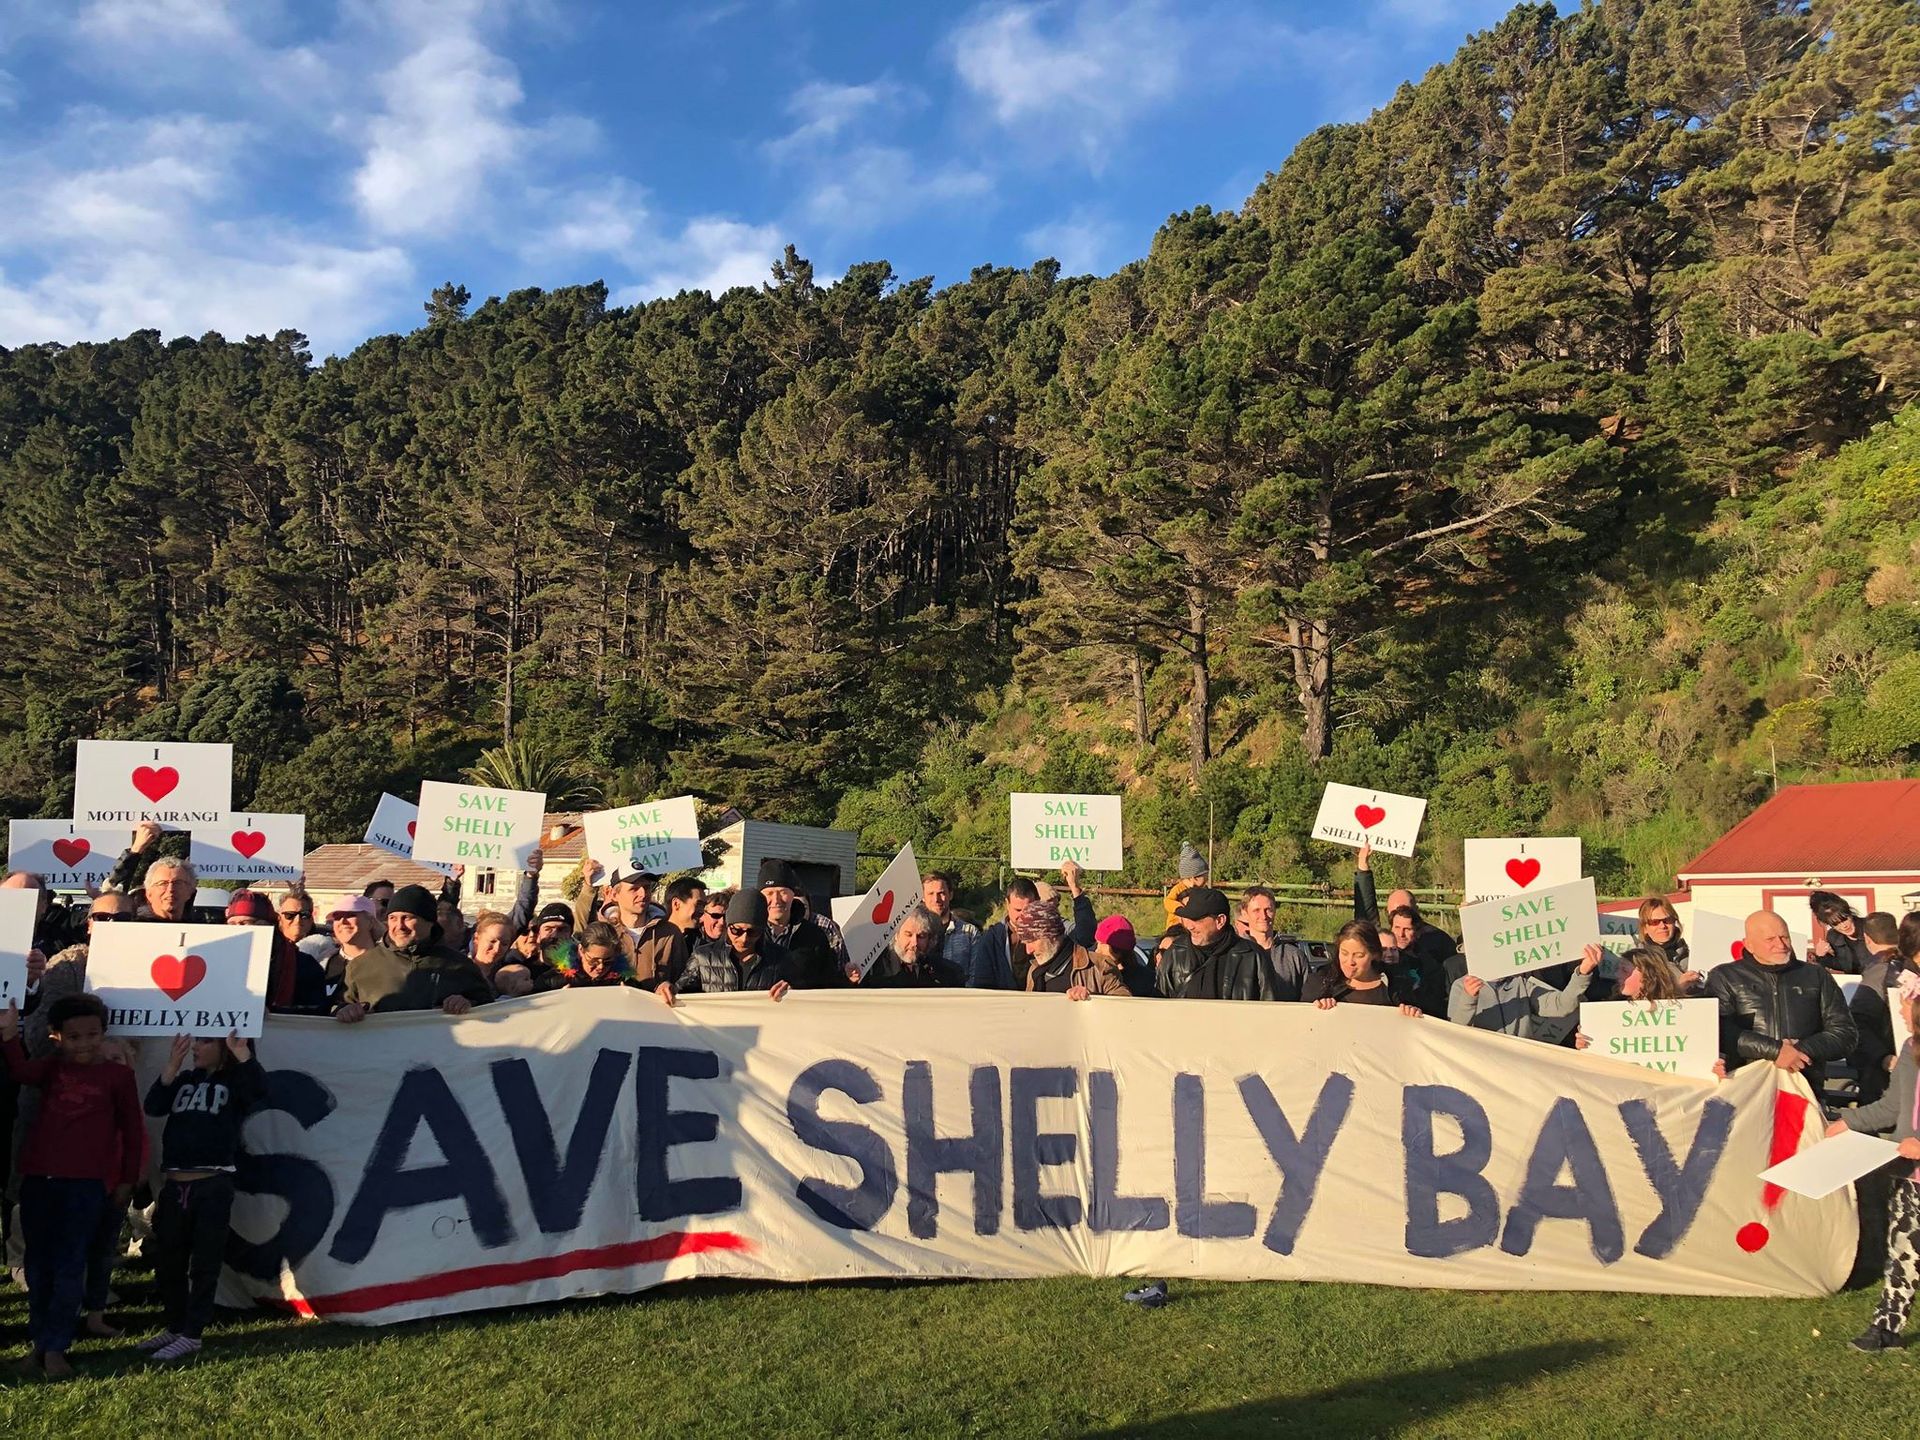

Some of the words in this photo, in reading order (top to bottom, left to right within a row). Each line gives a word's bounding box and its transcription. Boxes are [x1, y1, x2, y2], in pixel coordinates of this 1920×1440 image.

[153, 748, 160, 760] I
[458, 792, 509, 813] SAVE
[1372, 794, 1377, 803] I
[87, 810, 136, 821] MOTU
[140, 811, 219, 822] KAIRANGI
[1044, 800, 1089, 817] SAVE
[247, 817, 252, 827] I
[442, 815, 516, 837] SHELLY
[617, 808, 663, 829] SAVE
[69, 824, 74, 834] I
[1034, 823, 1098, 840] SHELLY
[1320, 825, 1373, 844] SHELLY
[1375, 836, 1407, 850] BAY!
[456, 840, 501, 860] BAY!
[610, 828, 674, 854] SHELLY
[1520, 843, 1526, 854] I
[1050, 846, 1090, 862] BAY!
[43, 872, 83, 885] ELLY
[199, 864, 235, 874] MOTU
[237, 865, 295, 875] KAIRANGI
[876, 887, 881, 897] I
[1501, 895, 1556, 922] SAVE
[860, 941, 883, 970] MOTU
[883, 892, 920, 940] KAIRANGI
[1492, 916, 1569, 949] SHELLY
[1604, 920, 1638, 935] SAV
[179, 932, 186, 947] I
[1513, 940, 1562, 966] BAY!
[108, 1008, 191, 1028] HELLY
[194, 1010, 250, 1028] BAY!
[1621, 1008, 1677, 1027] SAVE
[1609, 1034, 1689, 1055] SHELLY
[171, 1081, 230, 1115] GAP
[224, 1044, 745, 1281] SAVE
[786, 1057, 1358, 1258] SHELLY
[1402, 1083, 1810, 1266] BAY!
